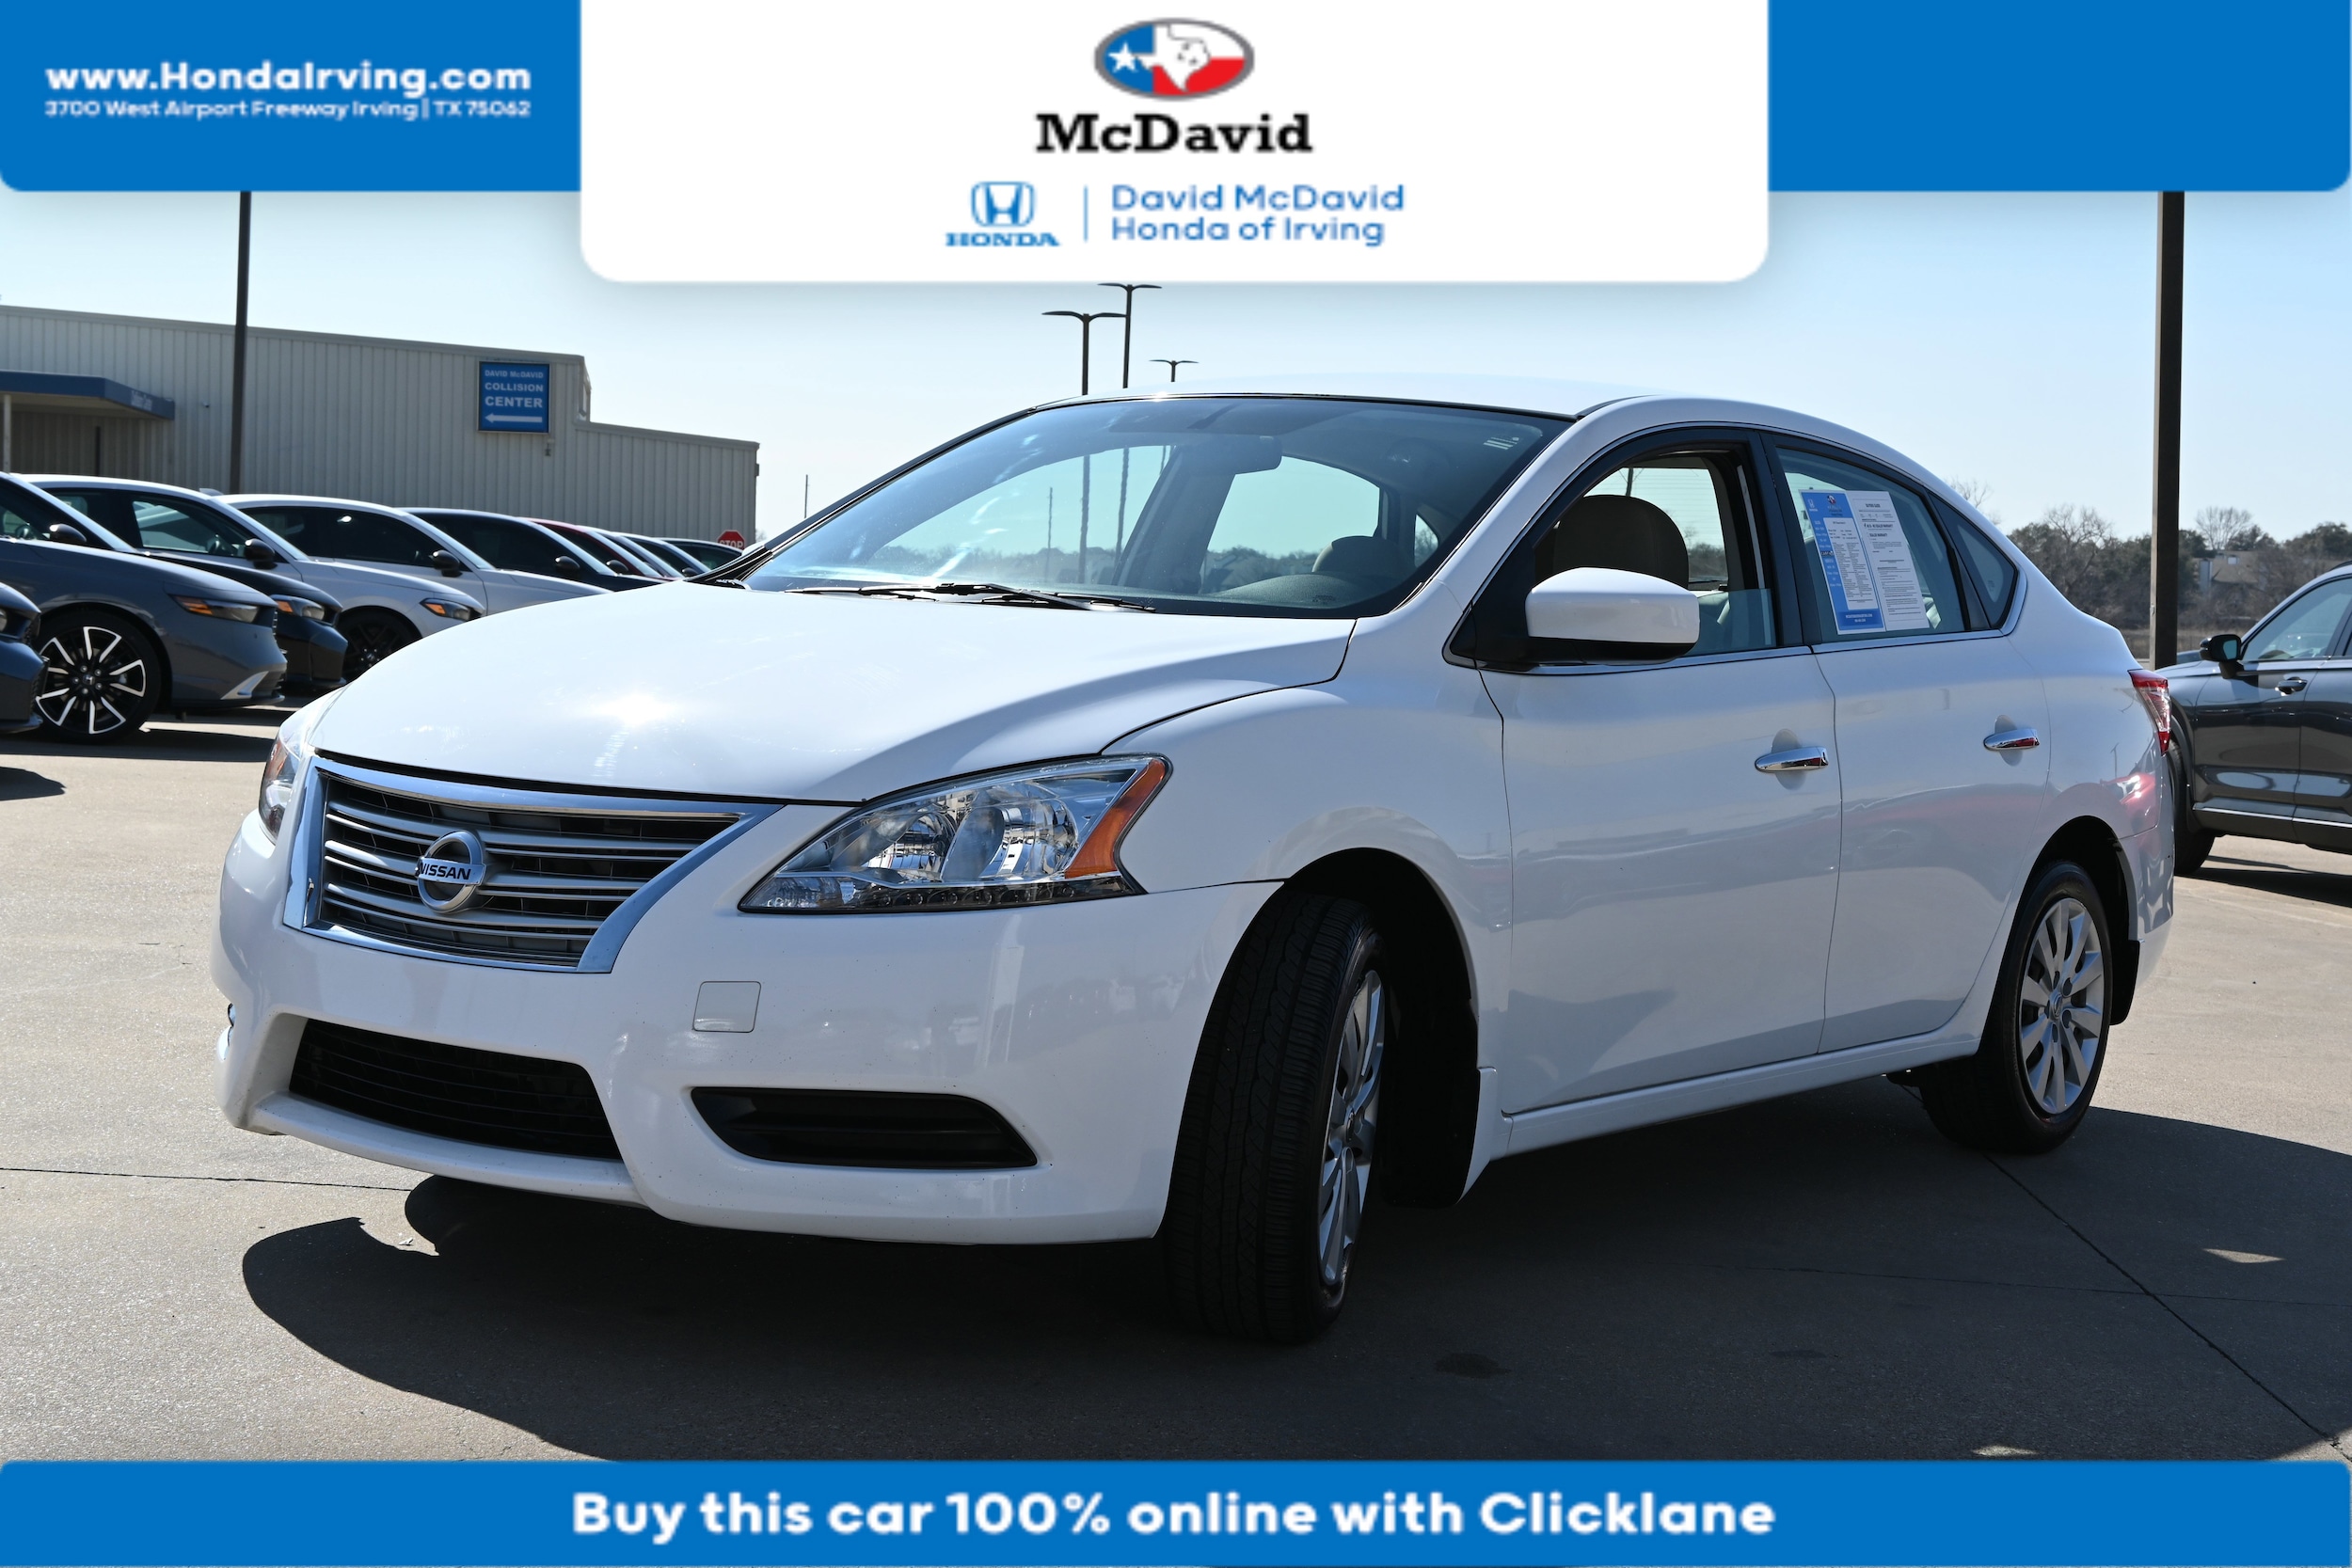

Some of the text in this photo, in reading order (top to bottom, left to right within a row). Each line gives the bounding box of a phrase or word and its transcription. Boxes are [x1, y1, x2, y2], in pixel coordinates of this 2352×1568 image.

[485, 382, 544, 392] COLLISION
[485, 396, 543, 408] CENTER
[419, 862, 471, 880] NISSAN
